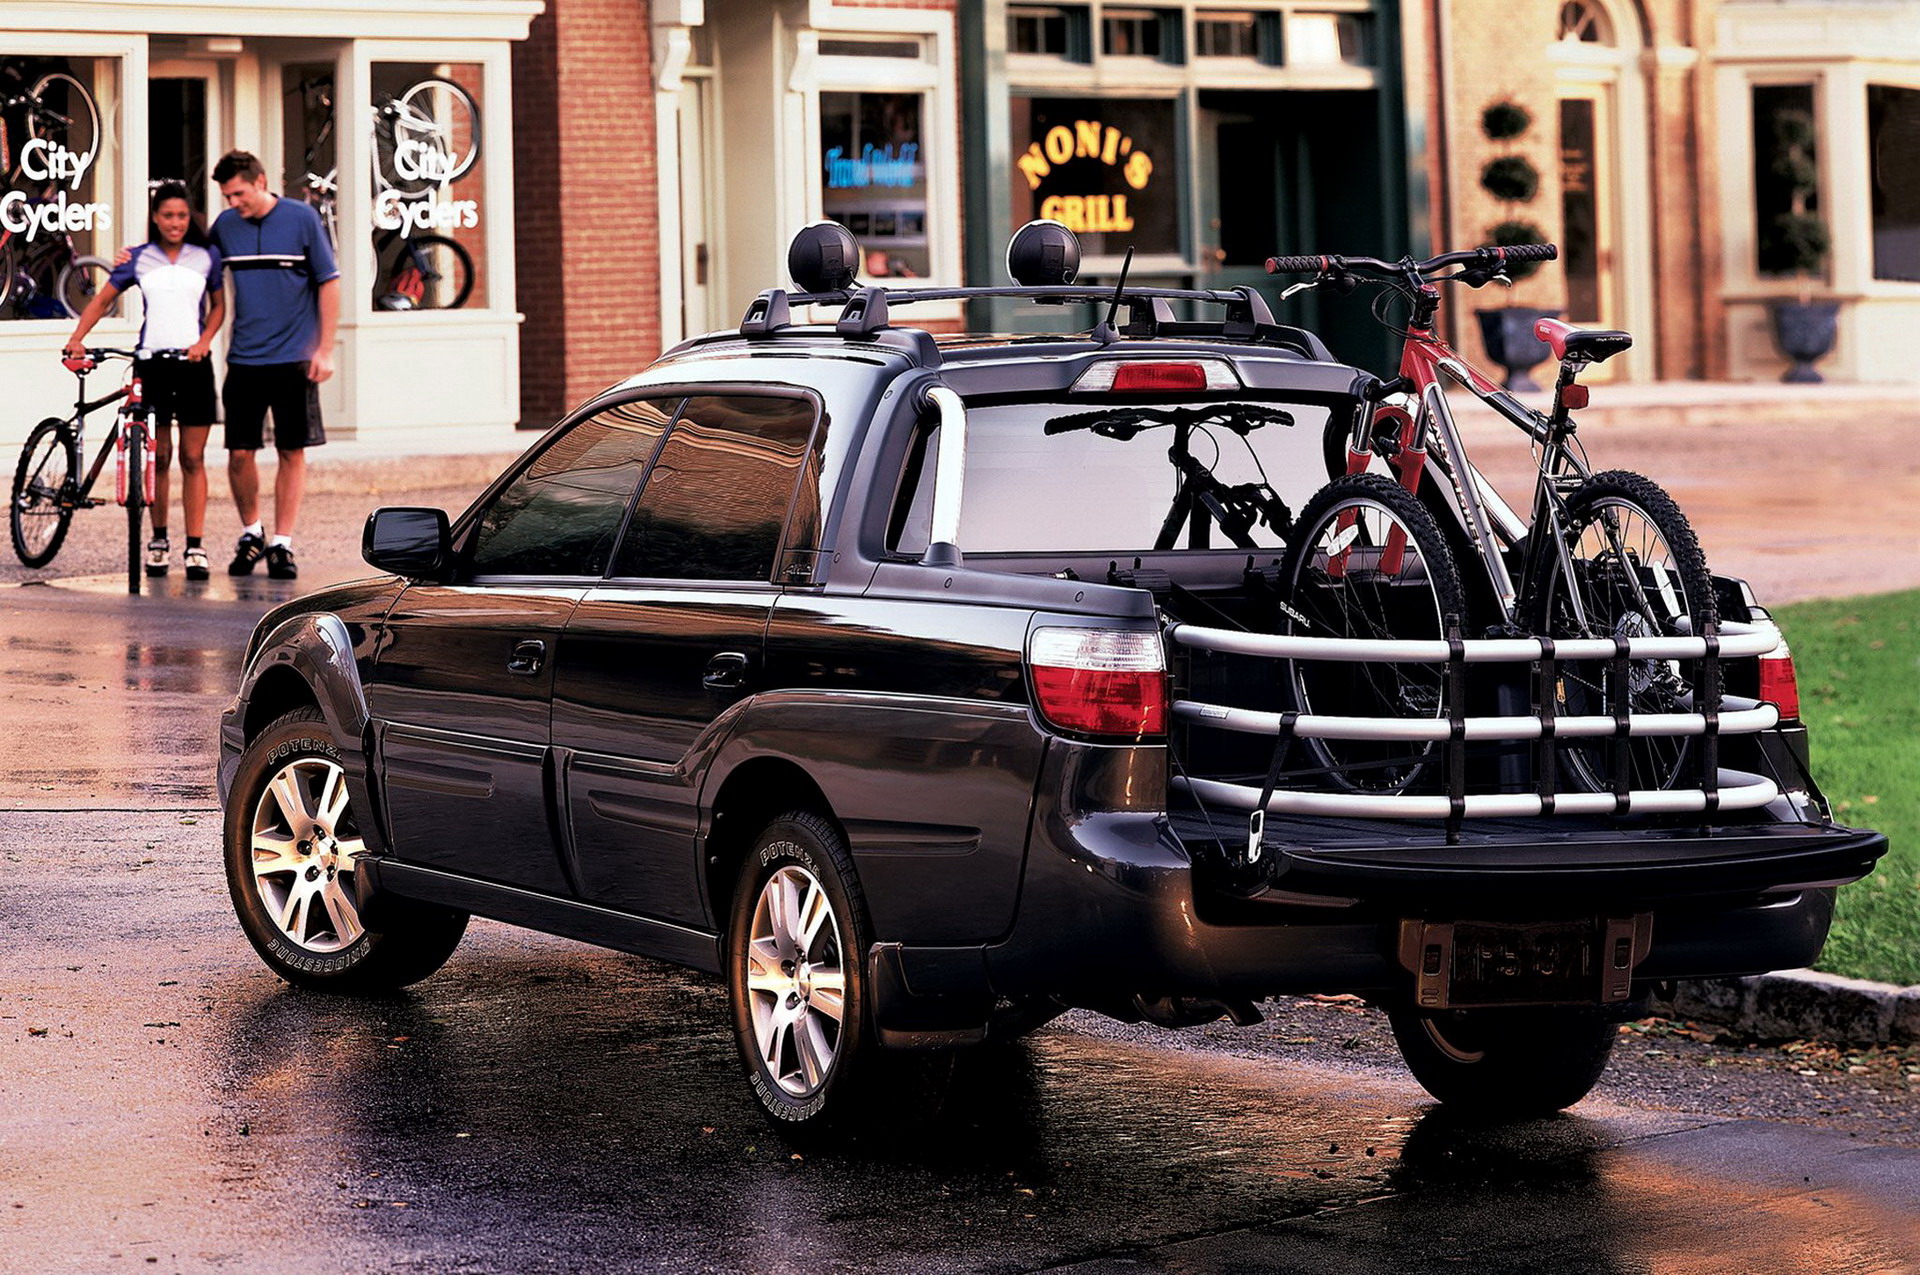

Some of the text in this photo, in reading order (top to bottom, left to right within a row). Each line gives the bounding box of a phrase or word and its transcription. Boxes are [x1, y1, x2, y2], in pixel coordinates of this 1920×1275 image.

[20, 138, 90, 190] City
[393, 139, 458, 188] City
[1016, 119, 1154, 190] NONI'S
[0, 190, 112, 242] Cyclers
[375, 189, 479, 239] Cyclers
[1040, 194, 1135, 233] GRILL
[1280, 601, 1311, 629] SUBARU
[266, 738, 344, 765] POTENZ
[266, 937, 371, 973] BRIDGESTONE
[749, 1070, 826, 1121] BRIDGESTONE
